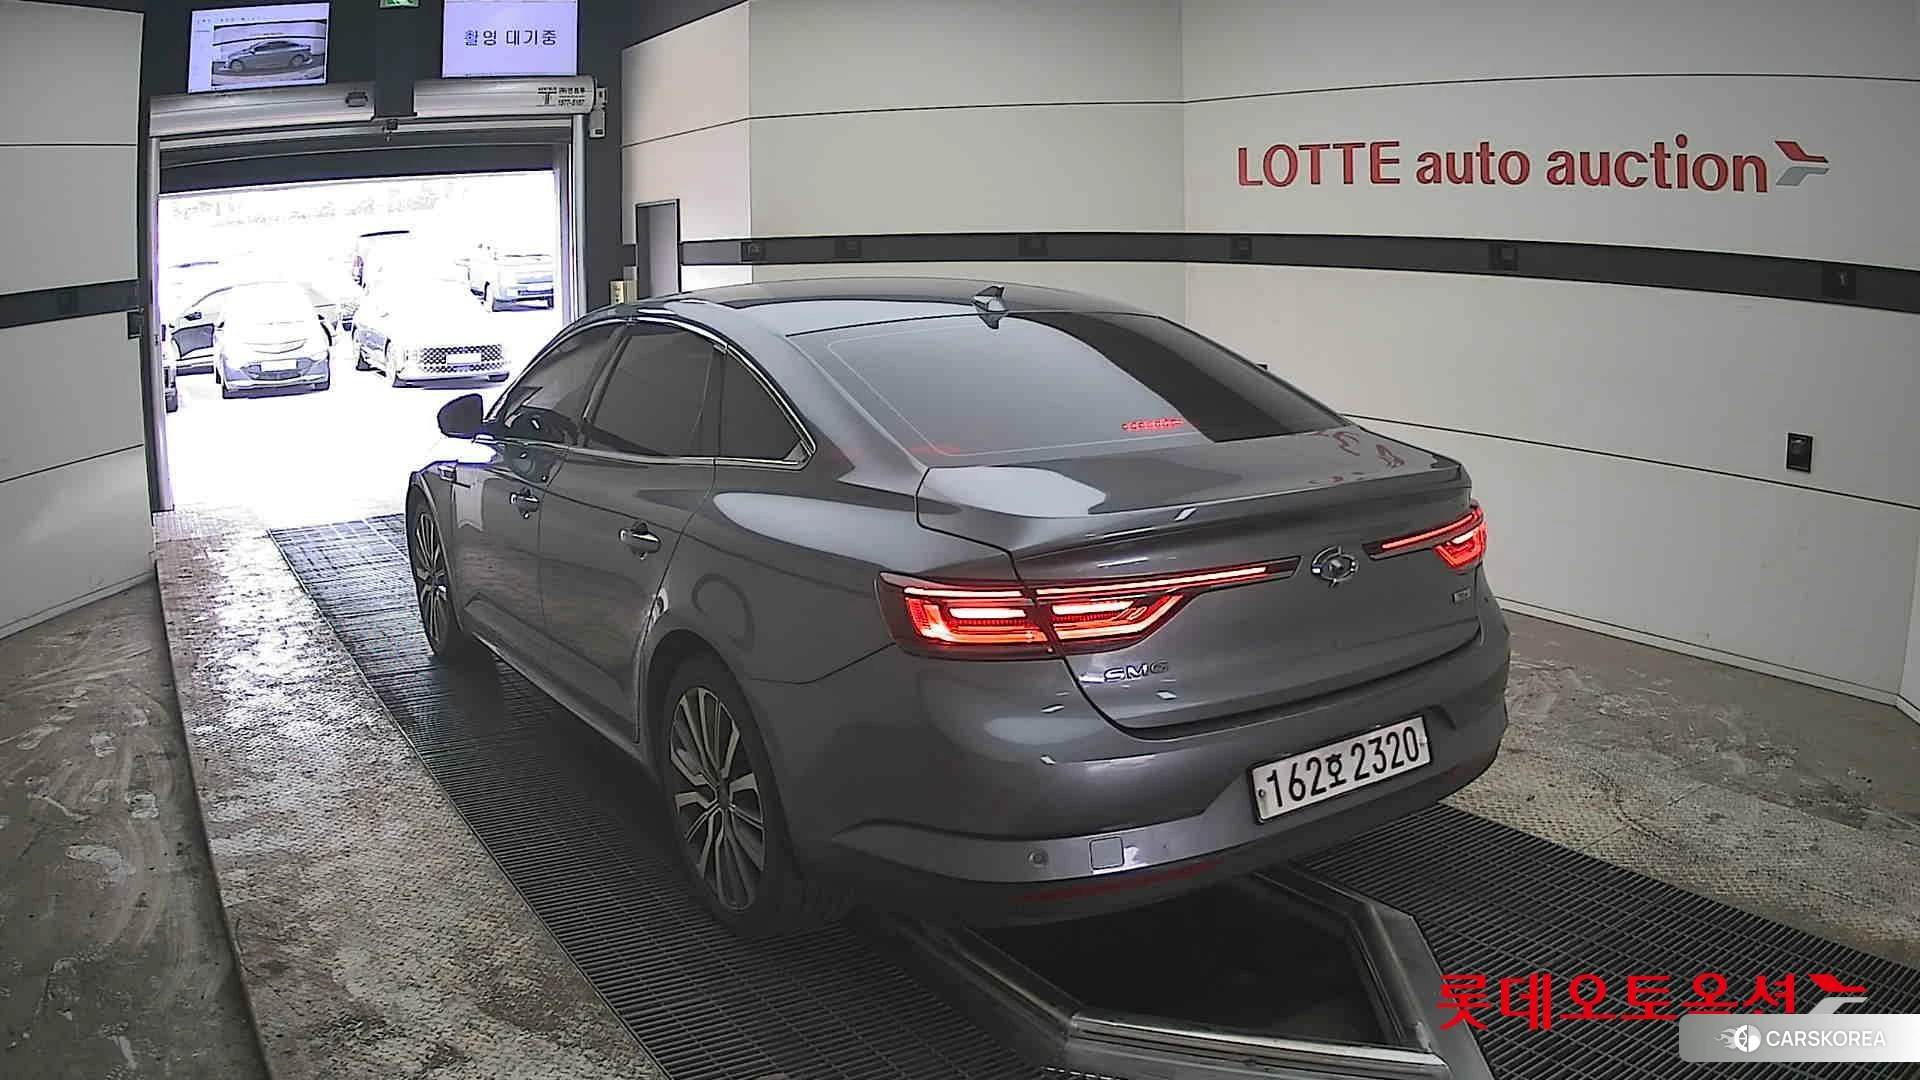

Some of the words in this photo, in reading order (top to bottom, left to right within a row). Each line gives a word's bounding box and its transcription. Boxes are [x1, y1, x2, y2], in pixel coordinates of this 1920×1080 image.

[505, 29, 557, 46] 대기중
[1237, 140, 1401, 188] LOTTE
[1415, 142, 1531, 186] auto
[1545, 134, 1768, 192] auction
